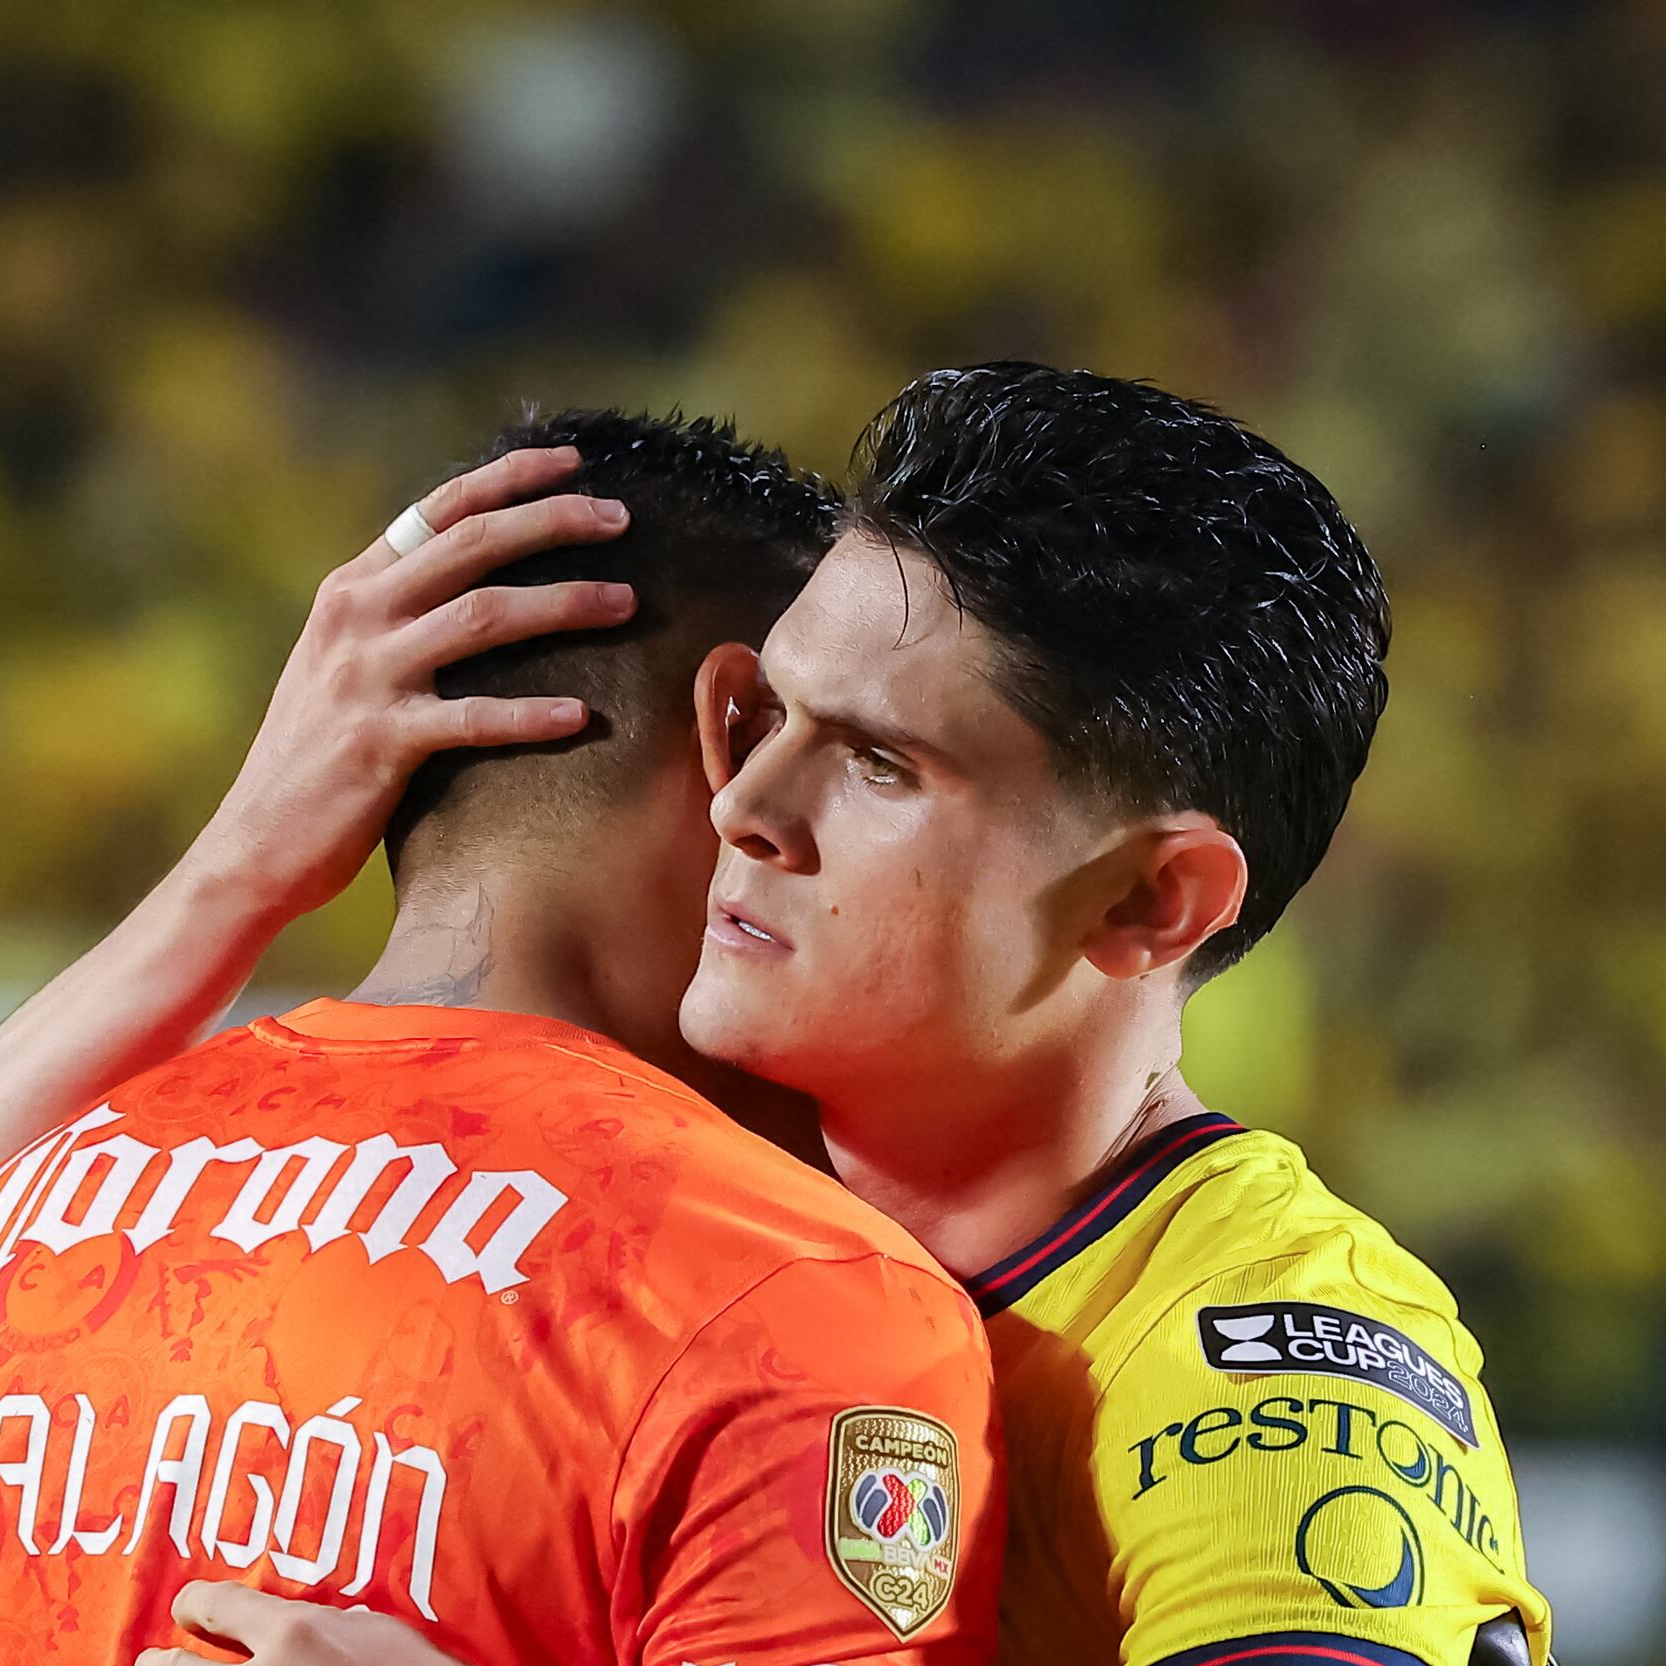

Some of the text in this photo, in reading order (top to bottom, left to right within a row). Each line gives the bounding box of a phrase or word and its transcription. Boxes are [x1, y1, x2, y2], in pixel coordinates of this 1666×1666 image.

[1284, 1313, 1465, 1410] LEAGUES
[1288, 1338, 1469, 1433] CUP 2024
[855, 1434, 949, 1467] CAMPEÓN
[934, 1558, 949, 1575] MX
